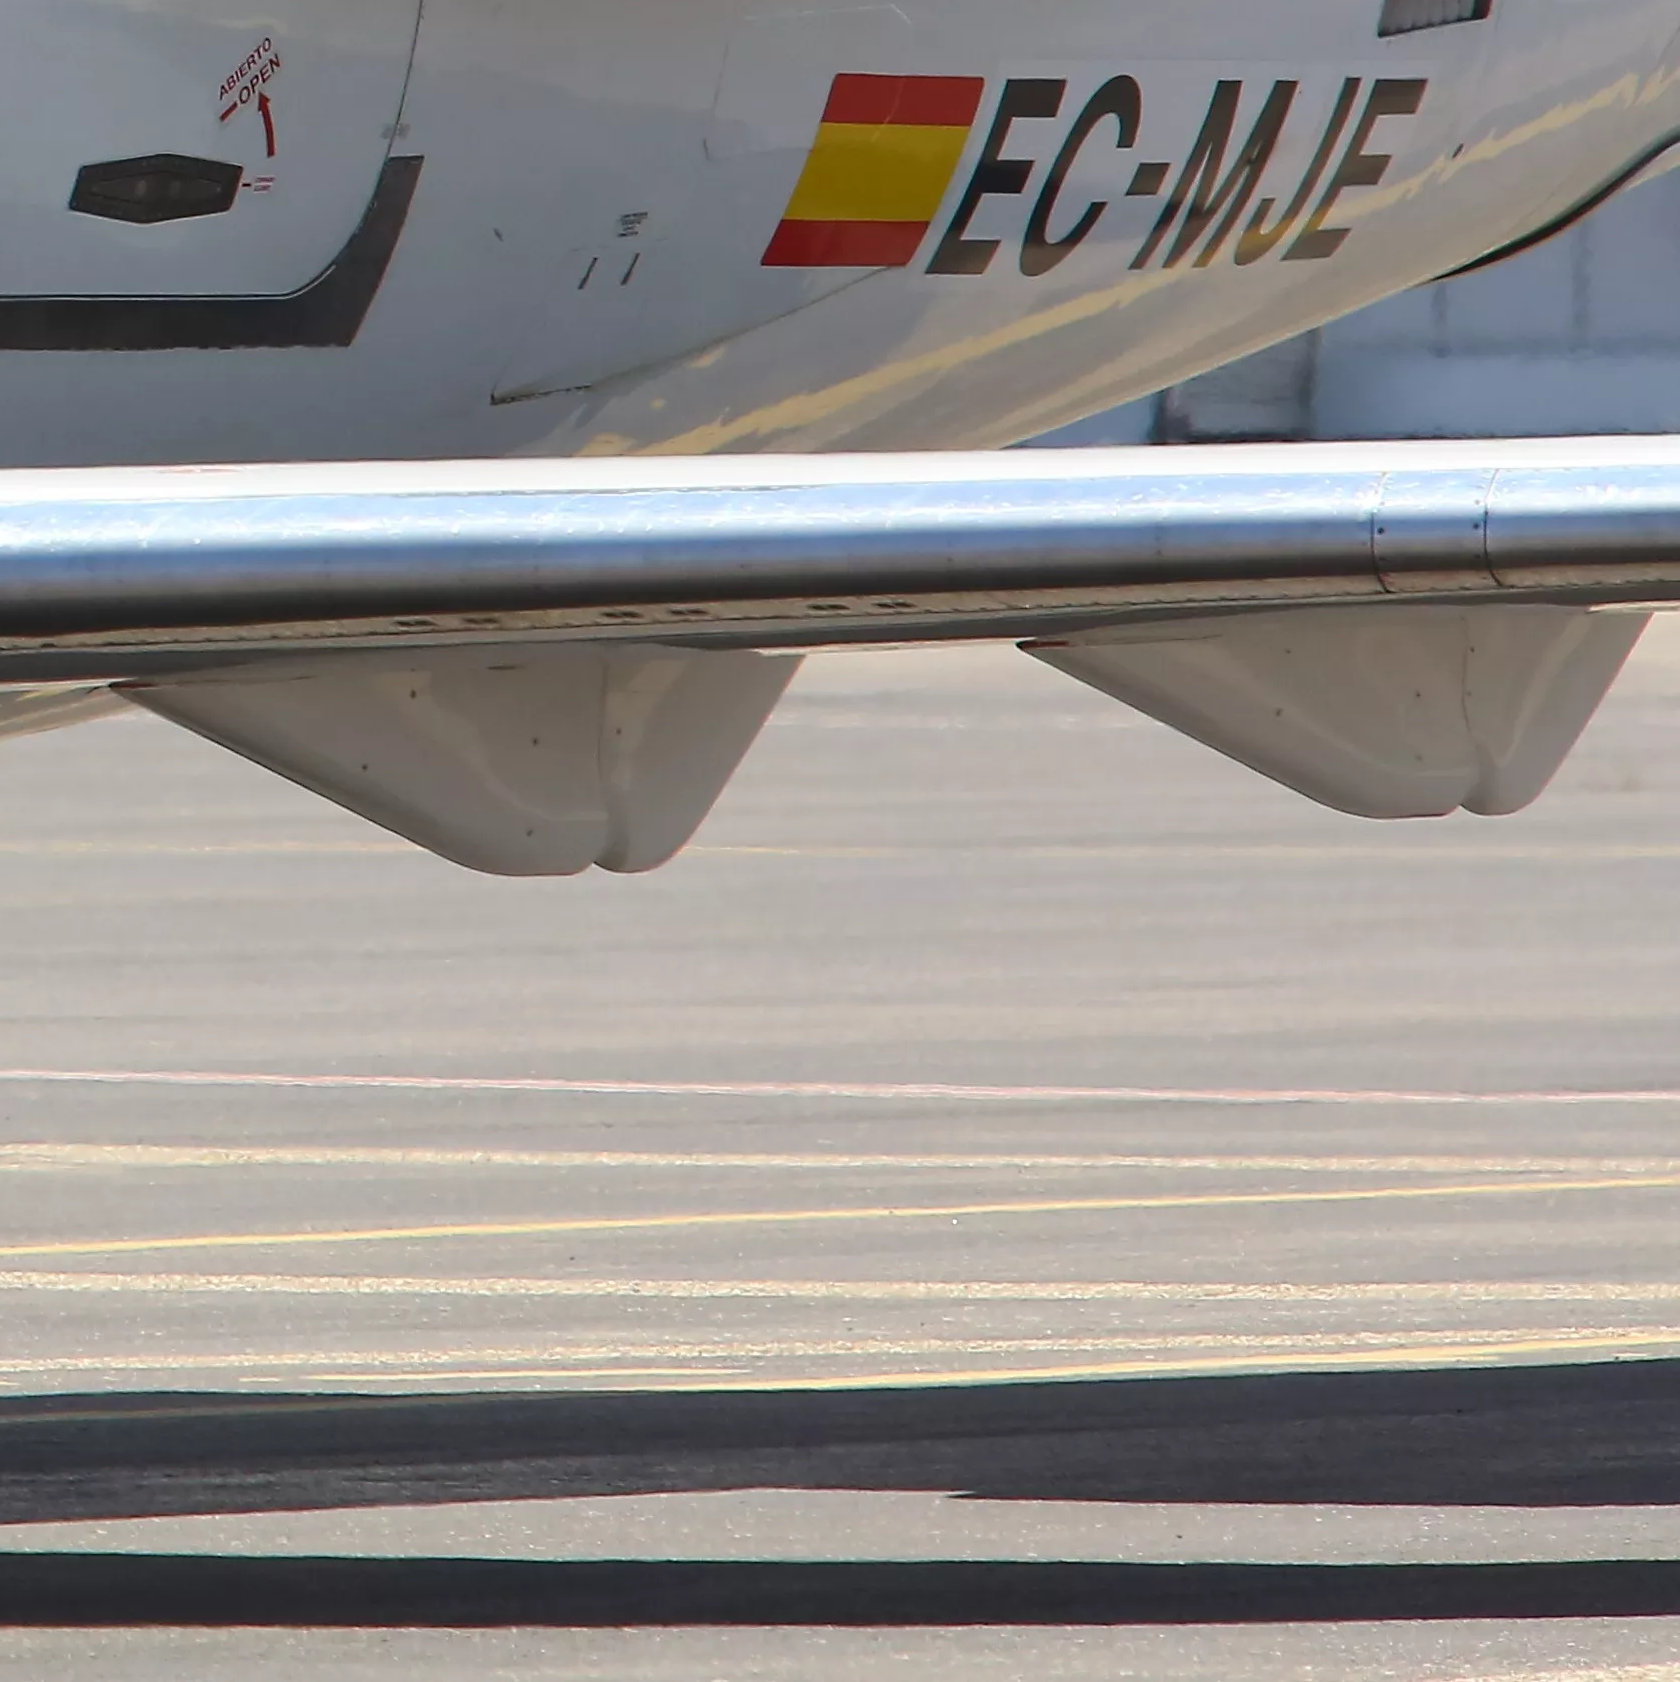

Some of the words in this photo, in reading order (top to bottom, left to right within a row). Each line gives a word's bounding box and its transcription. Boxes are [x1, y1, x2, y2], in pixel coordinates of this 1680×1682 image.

[218, 36, 273, 101] ABIERTO
[238, 53, 282, 105] OPEN
[924, 73, 1430, 278] EC-MJE
